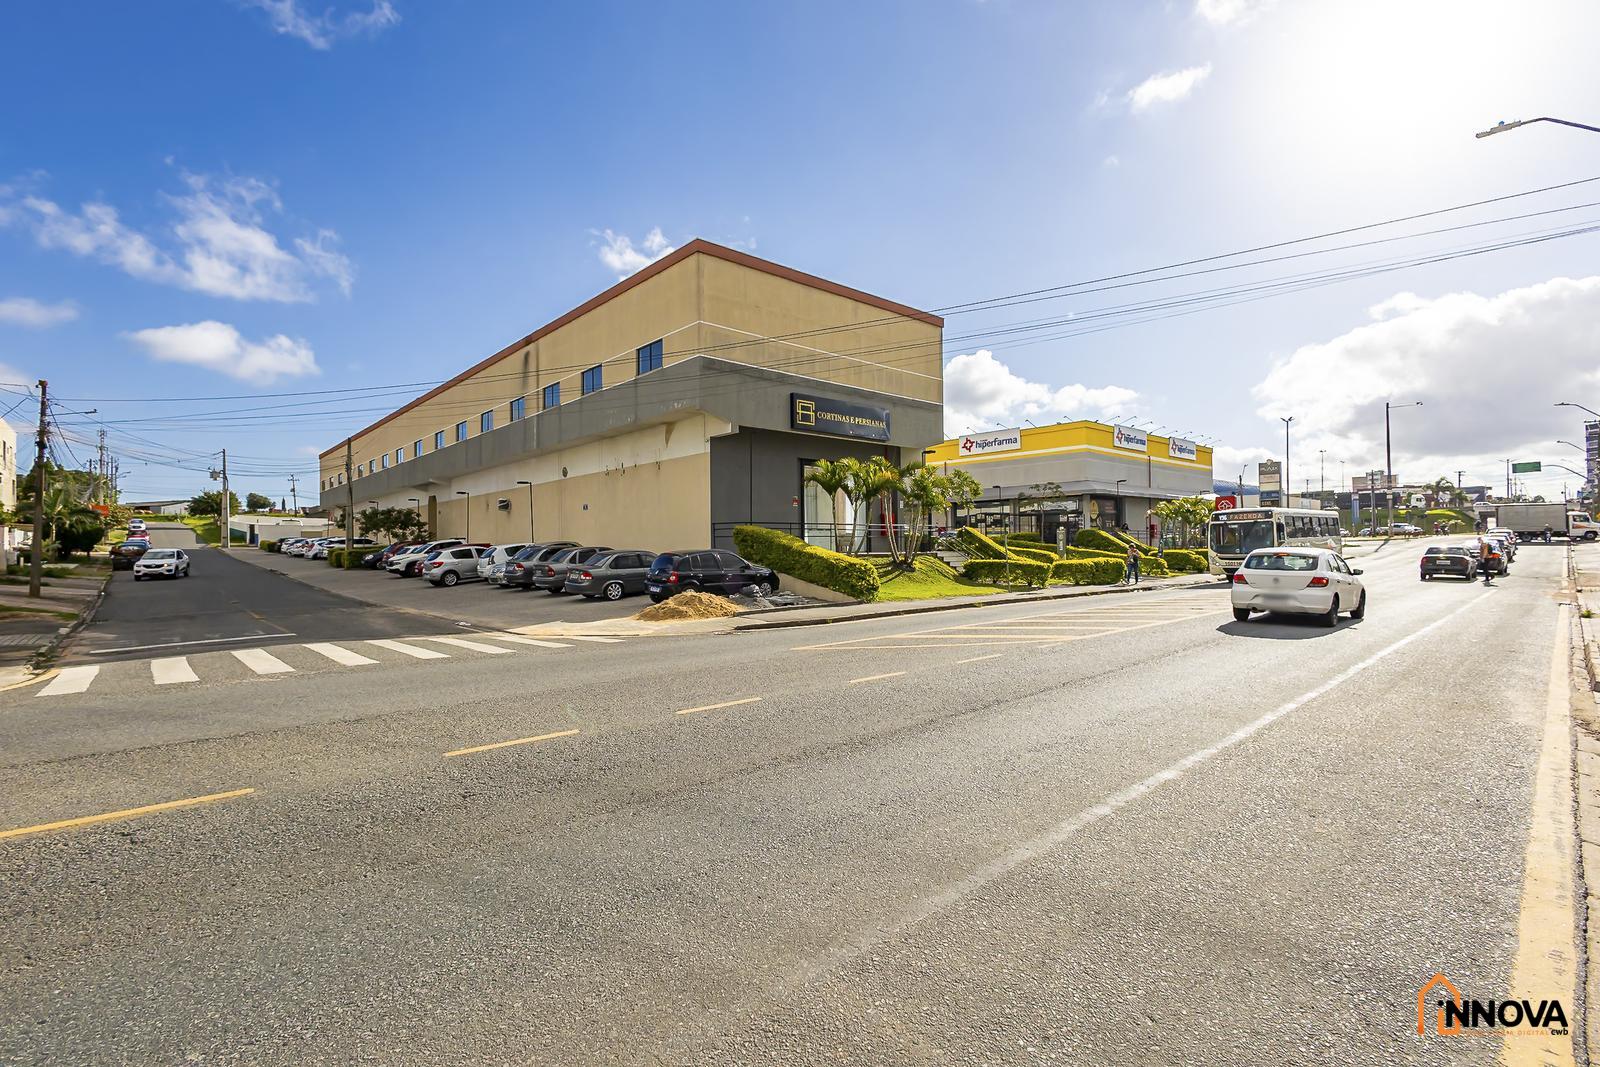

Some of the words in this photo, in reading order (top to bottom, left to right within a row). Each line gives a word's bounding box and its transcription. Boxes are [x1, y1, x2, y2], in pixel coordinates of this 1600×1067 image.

[817, 411, 849, 423] CORTINAS
[850, 416, 855, 424] E
[855, 417, 887, 429] PERSIANAS
[975, 437, 1018, 450] hiperfarma
